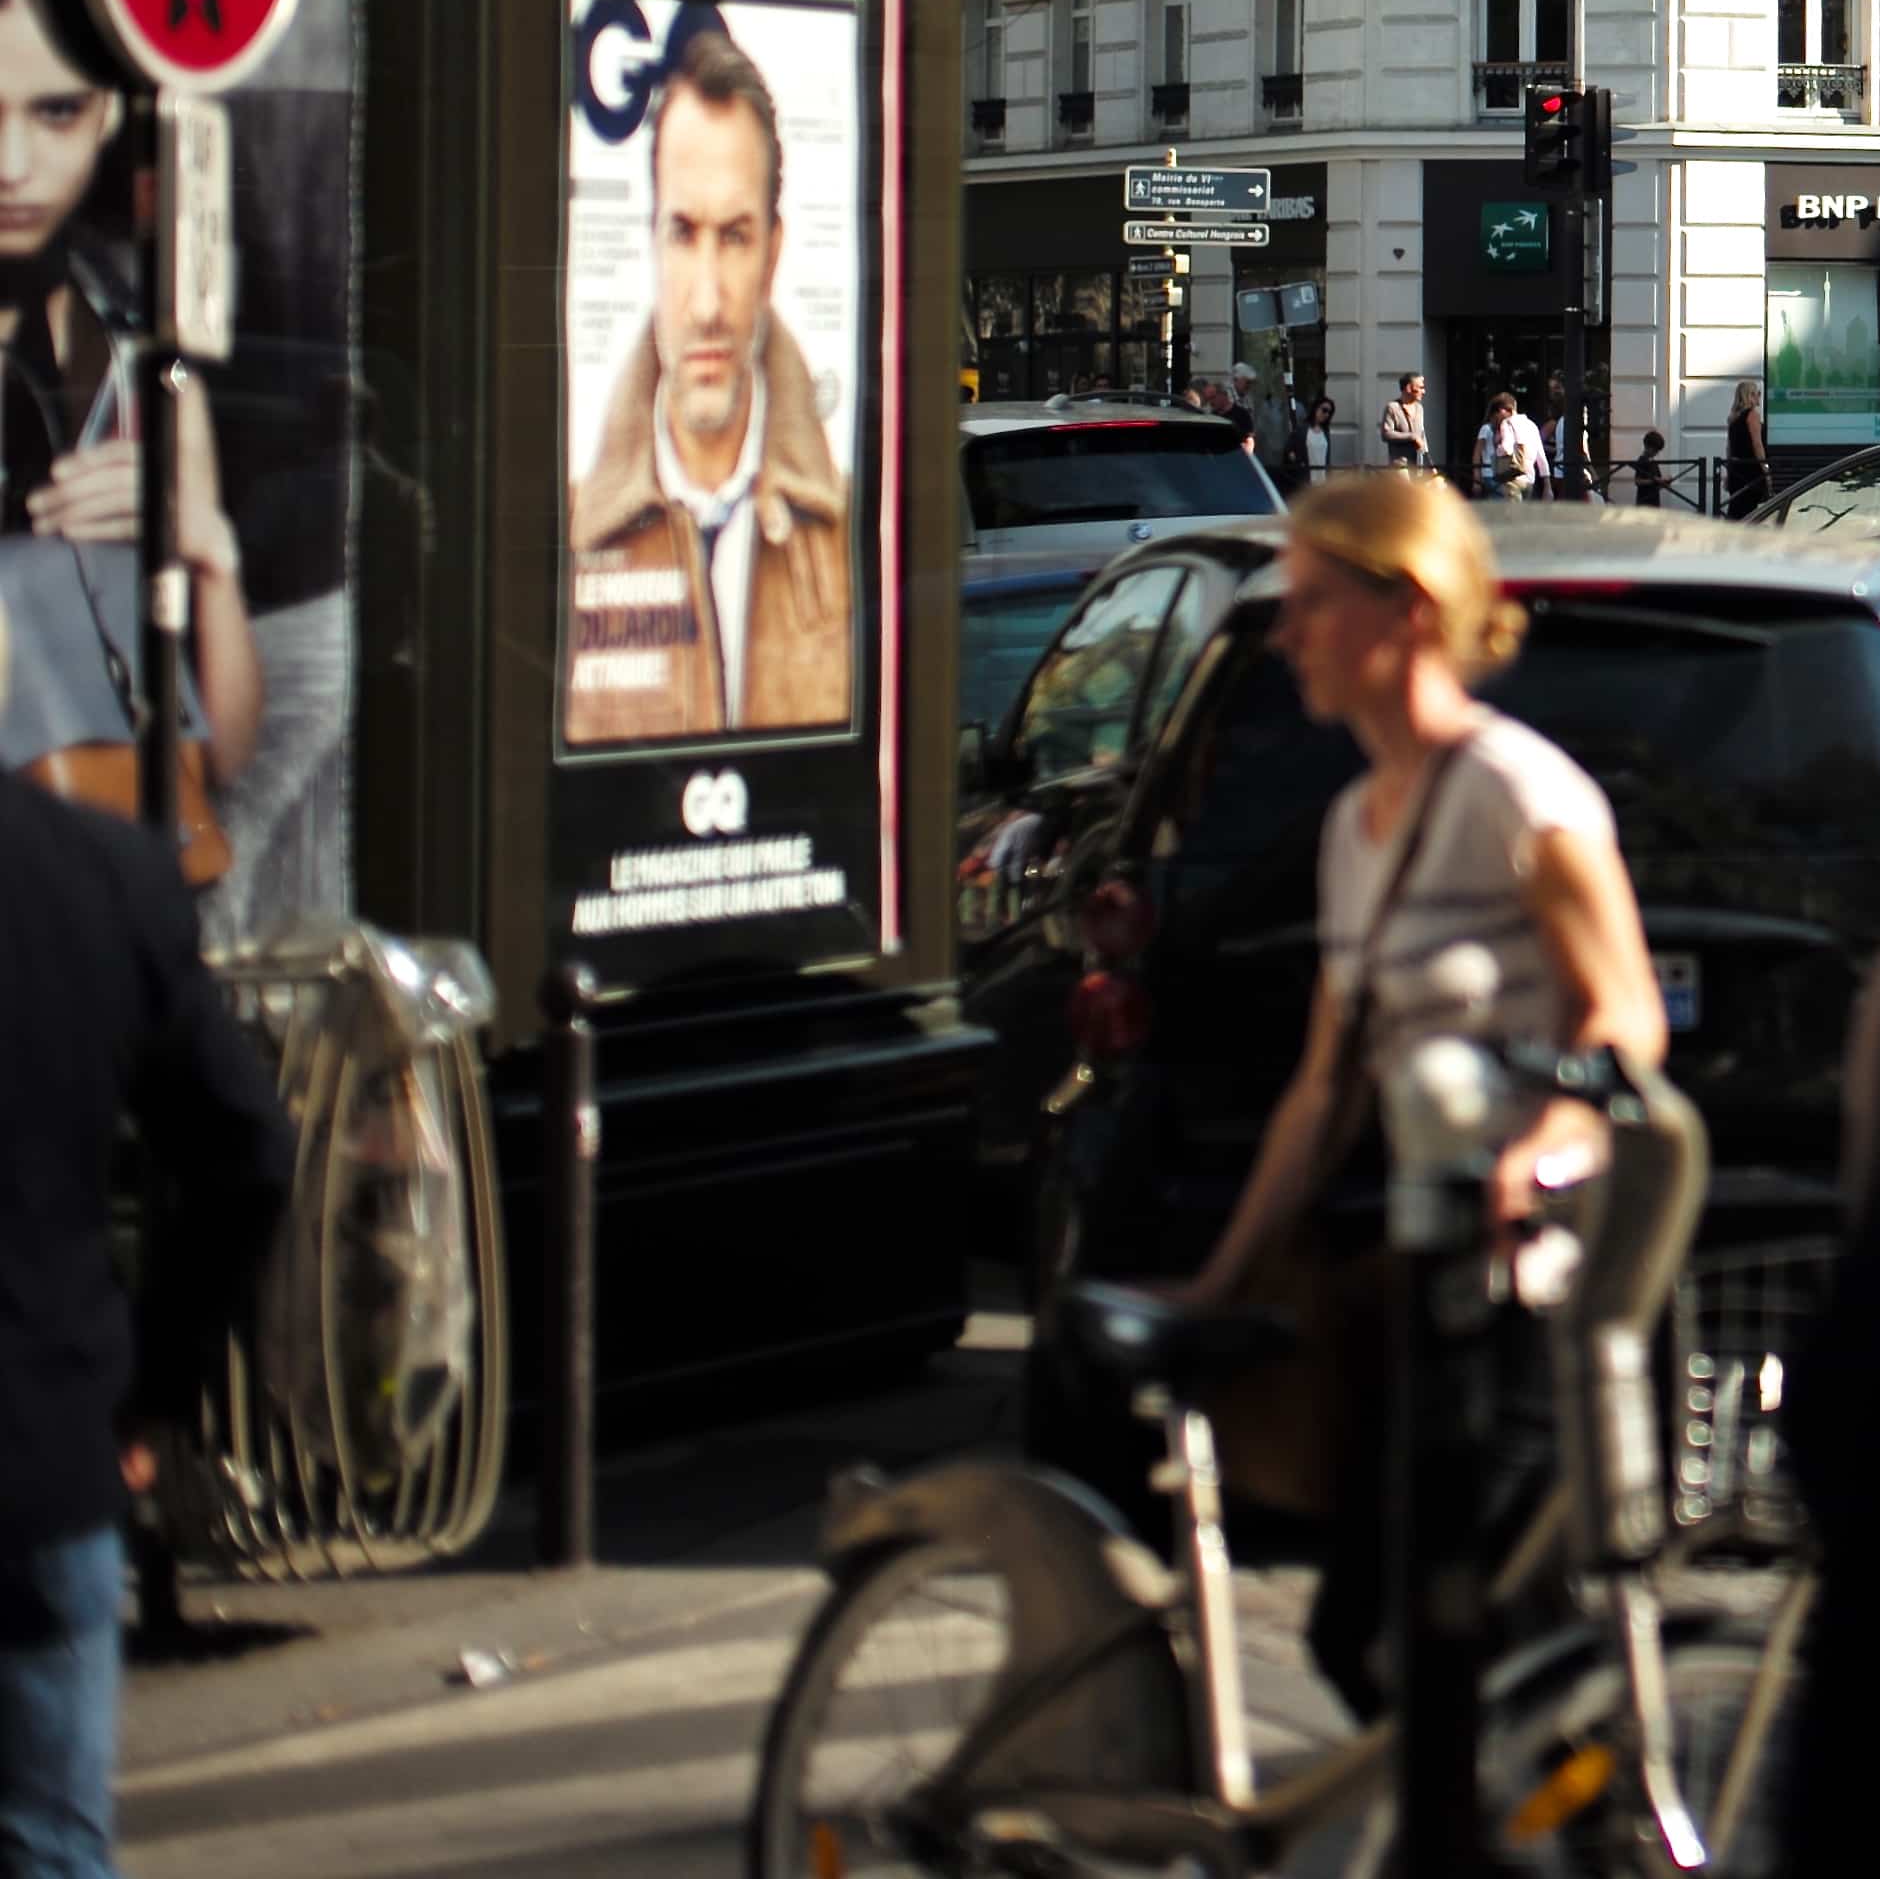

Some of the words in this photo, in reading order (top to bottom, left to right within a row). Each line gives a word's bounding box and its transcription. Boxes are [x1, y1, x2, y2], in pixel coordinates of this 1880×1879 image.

[1151, 172, 1183, 183] Mairie
[1185, 173, 1198, 183] du
[1151, 185, 1215, 195] commissariat
[1185, 198, 1226, 207] Bonaparte
[1797, 194, 1870, 220] BNP
[1147, 228, 1174, 239] Centre
[1175, 228, 1209, 240] Culturel
